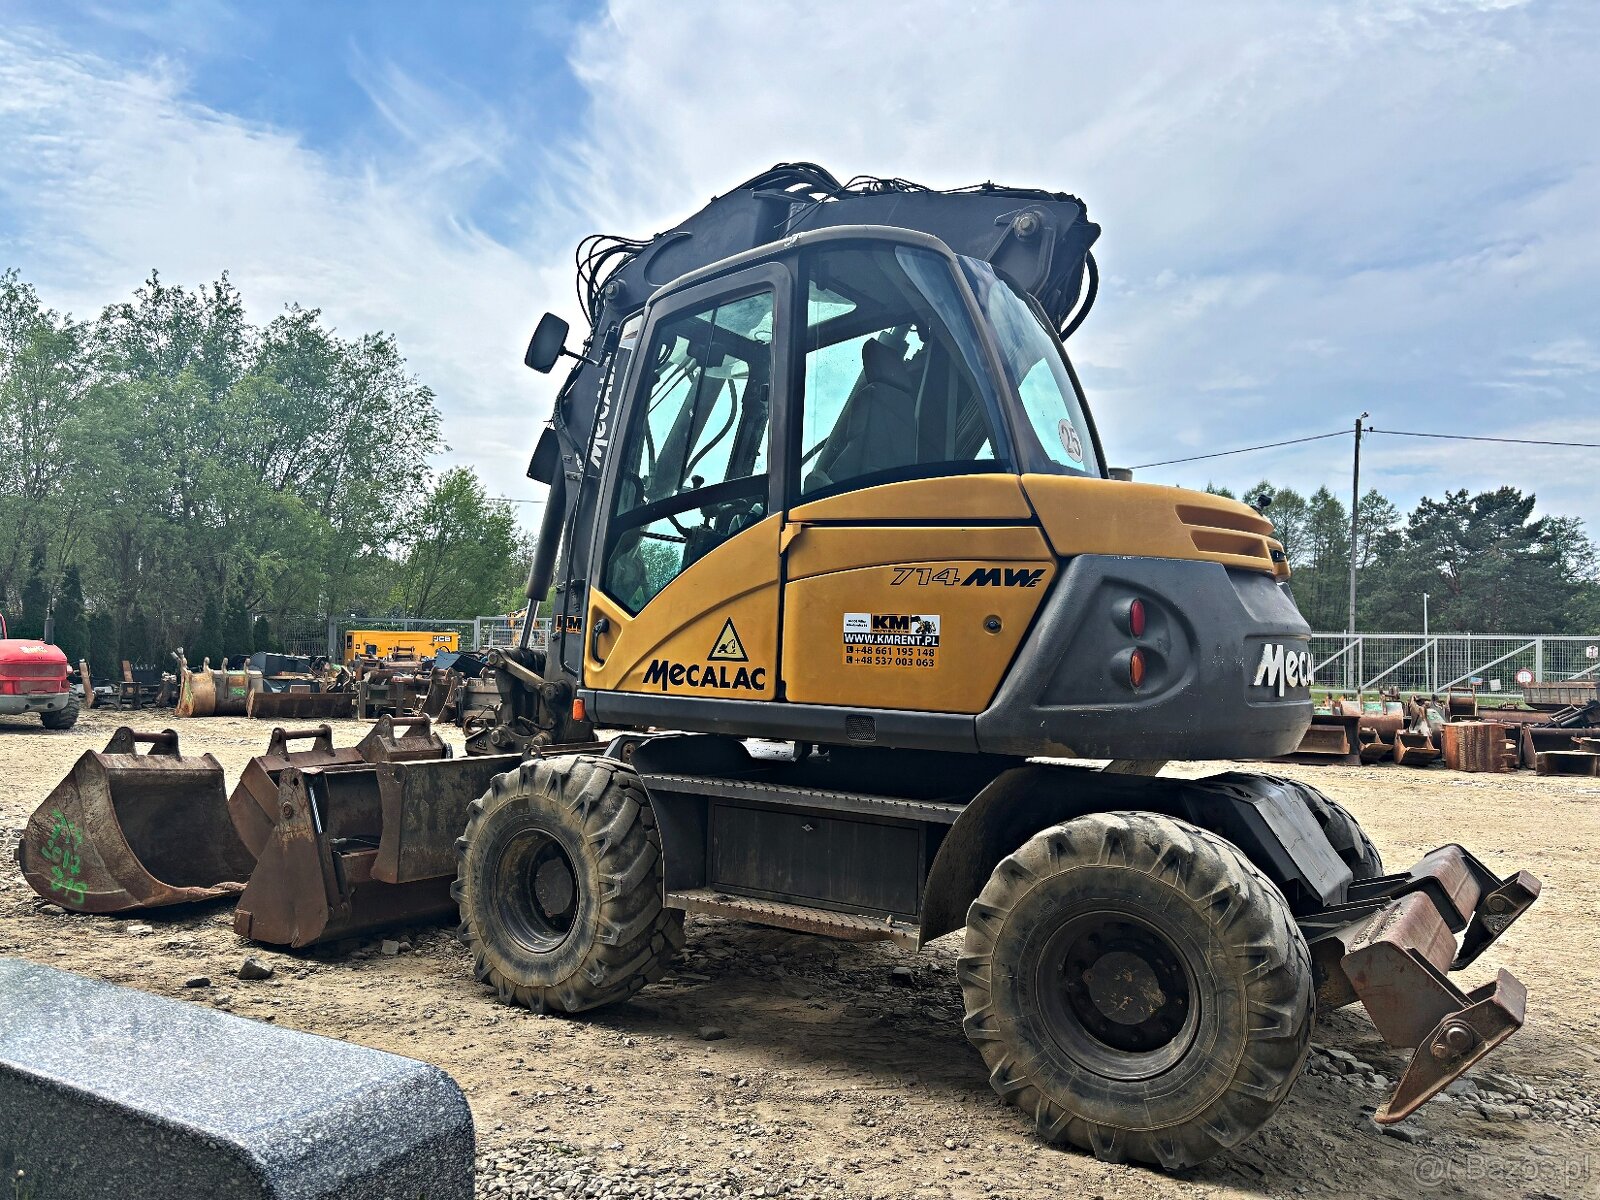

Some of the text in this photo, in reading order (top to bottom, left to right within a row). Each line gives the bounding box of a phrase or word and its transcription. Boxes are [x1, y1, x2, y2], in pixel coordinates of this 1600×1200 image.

[1061, 425, 1081, 456] 25
[890, 567, 960, 586] 714
[872, 615, 909, 629] KM
[844, 633, 939, 646] WWW.KMRENT.PL
[855, 646, 935, 657] +48 661 195 148
[855, 656, 934, 667] +48 537 003 063
